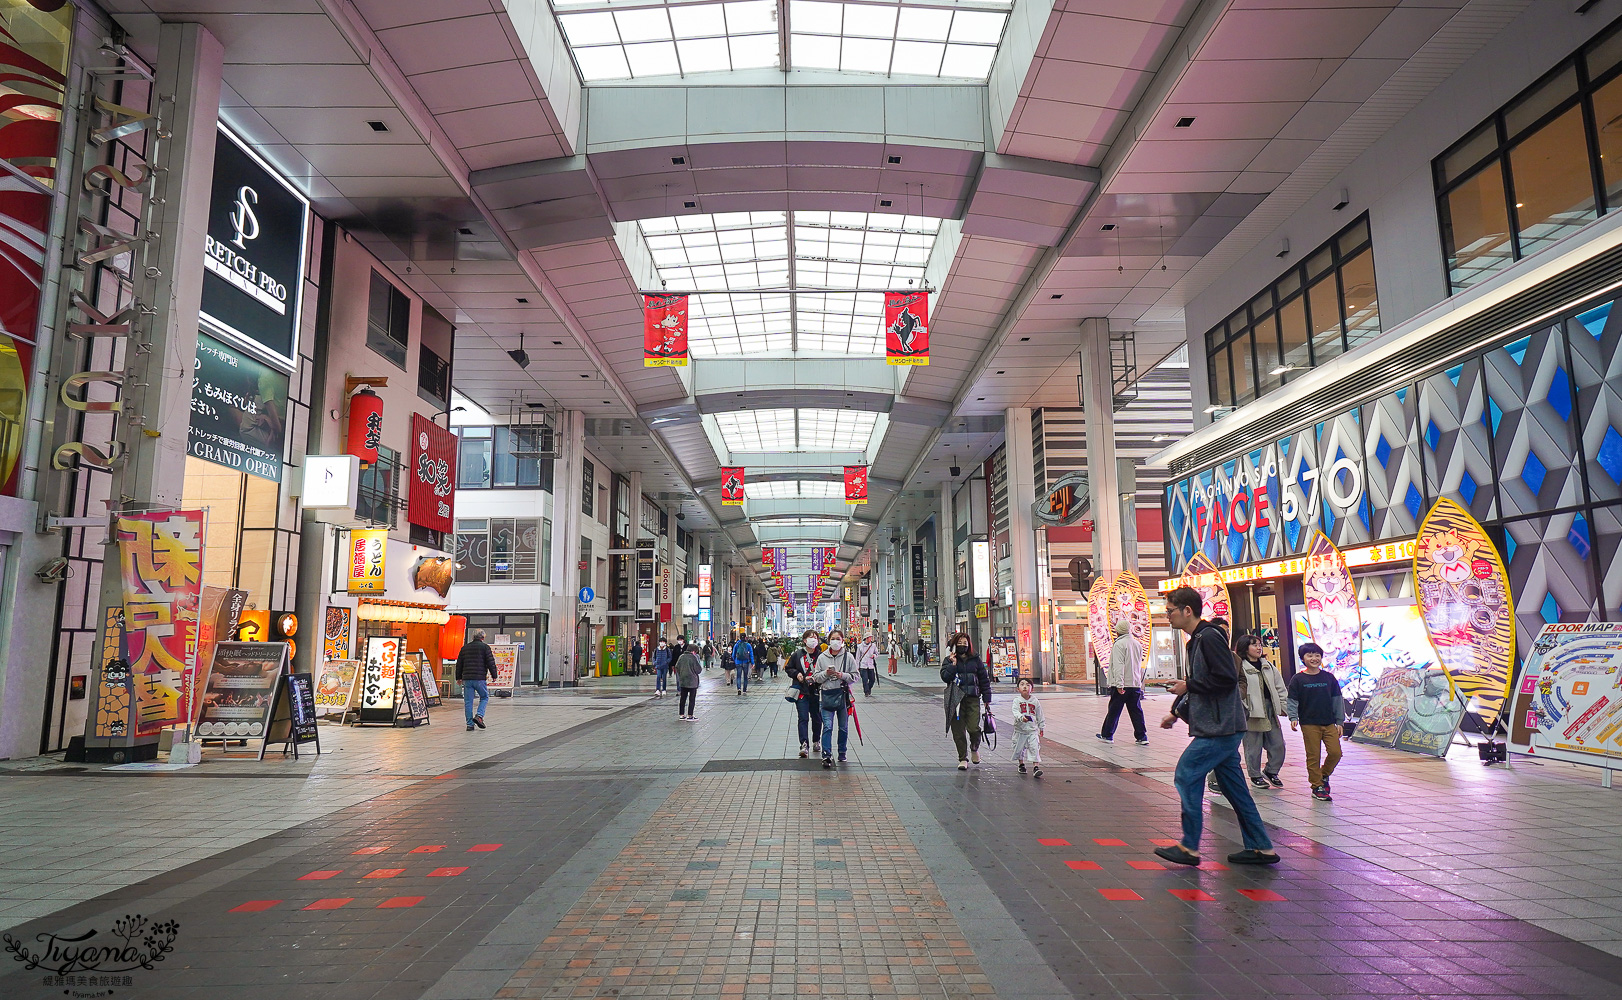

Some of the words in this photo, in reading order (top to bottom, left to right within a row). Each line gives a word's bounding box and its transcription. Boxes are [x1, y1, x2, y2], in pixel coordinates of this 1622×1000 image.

[259, 271, 286, 300] PRO
[194, 441, 242, 467] GRAND
[245, 457, 278, 479] OPEN
[1195, 472, 1249, 503] PACHINKO
[1255, 458, 1284, 482] SLOT
[1196, 486, 1270, 543] FACE
[1281, 457, 1362, 522] 570
[369, 539, 382, 577] うどん
[662, 568, 671, 600] docomo
[1422, 580, 1500, 608] FACE
[1544, 624, 1584, 632] FLOOR
[1582, 623, 1614, 631] MAP
[381, 640, 397, 679] つけ麺
[365, 657, 382, 706] おんのじ
